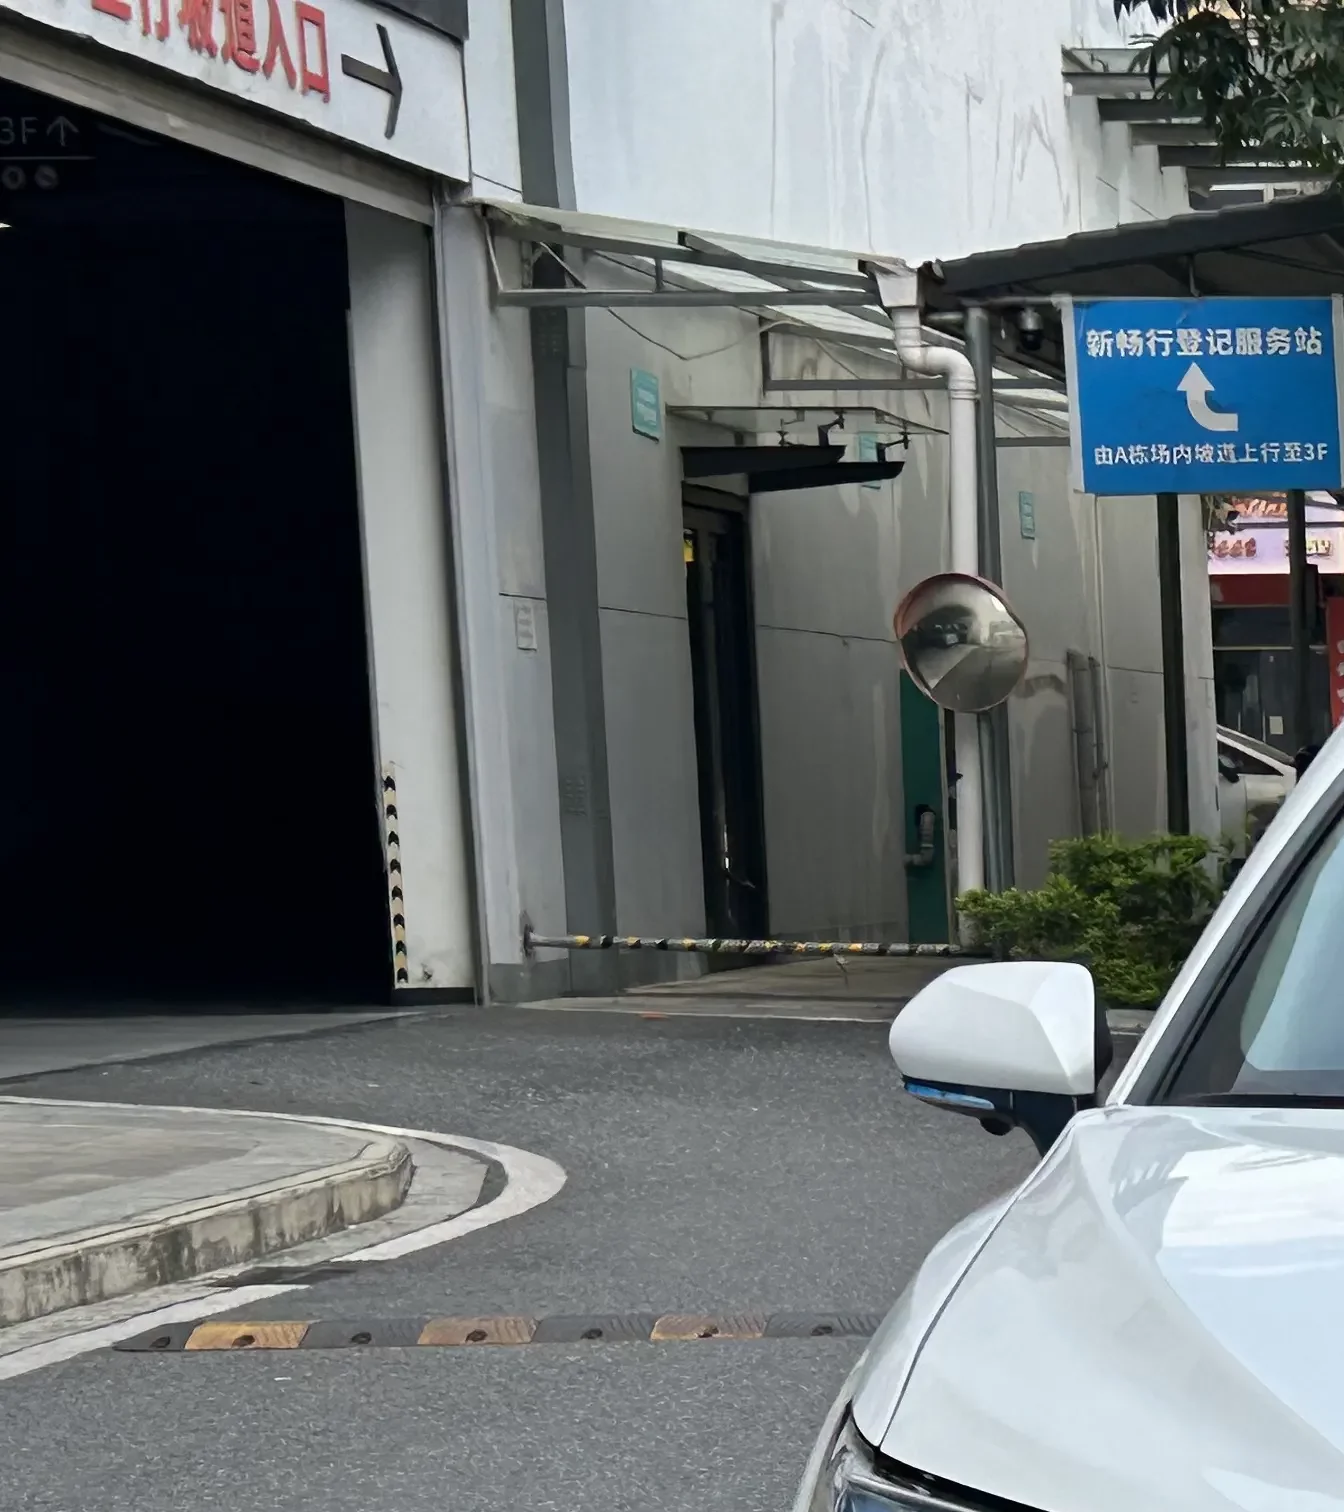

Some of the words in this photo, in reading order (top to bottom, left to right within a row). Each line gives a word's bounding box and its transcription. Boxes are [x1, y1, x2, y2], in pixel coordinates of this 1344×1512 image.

[1086, 326, 1323, 358] 新畅行登记服务站
[1094, 443, 1329, 465] 由A栋场内坡道上行至3F
